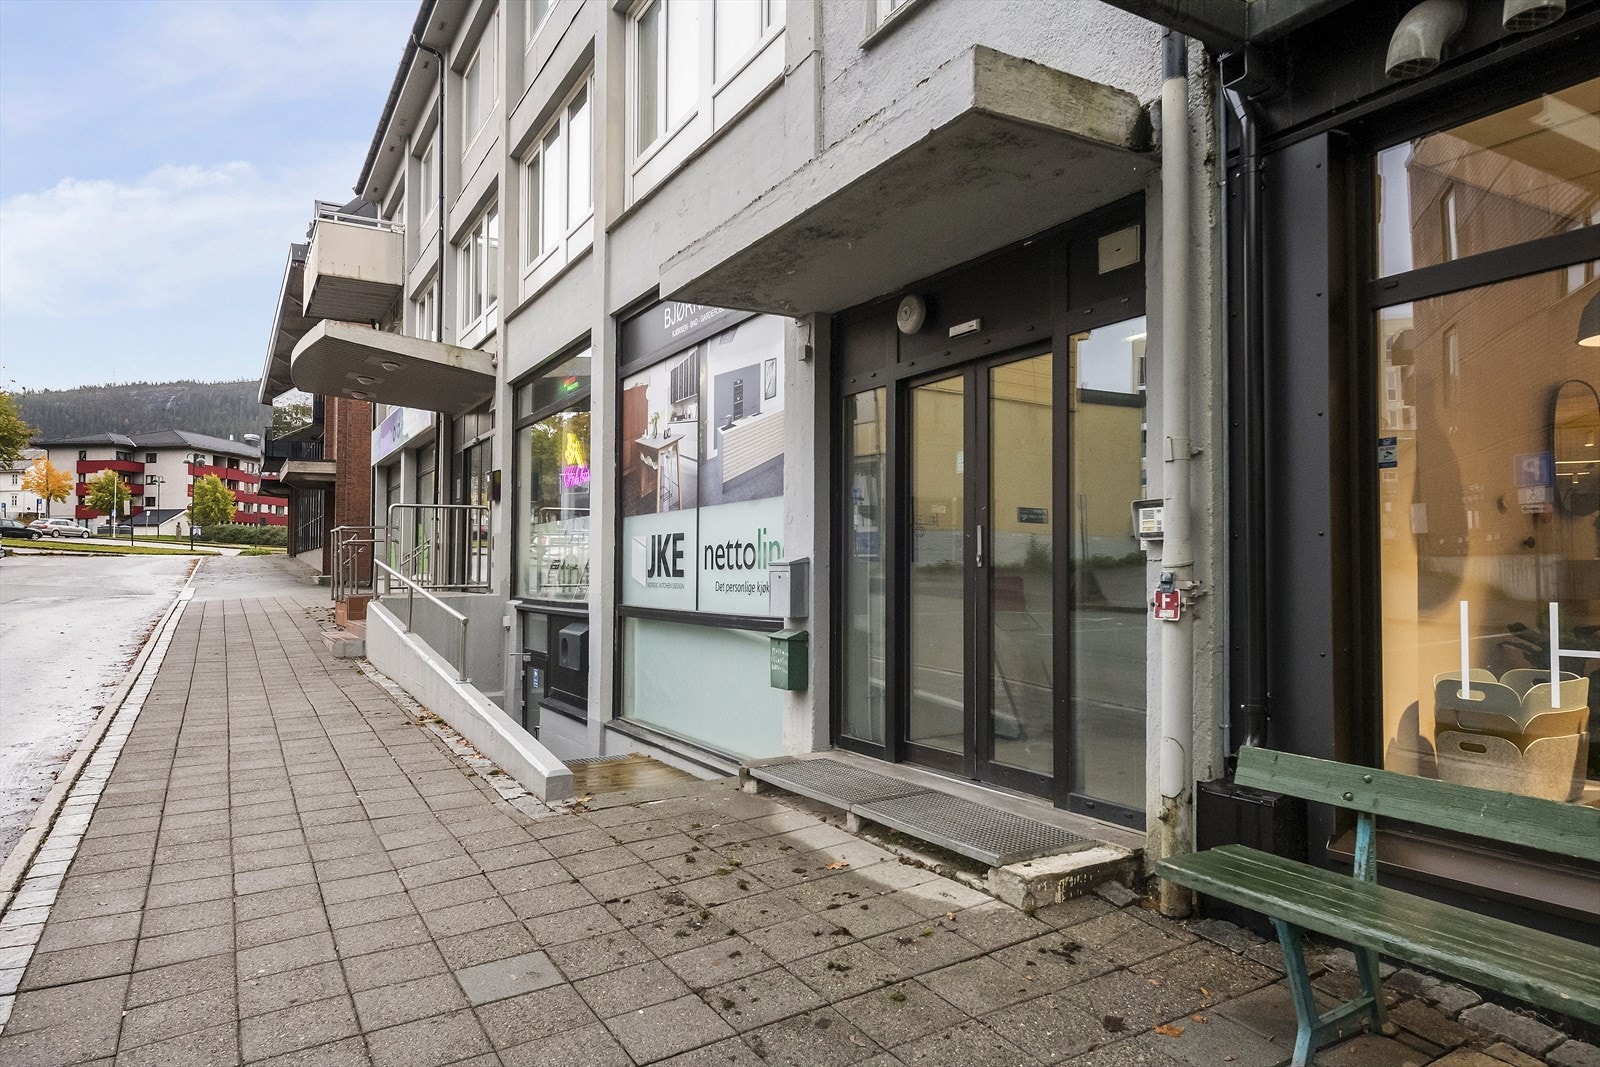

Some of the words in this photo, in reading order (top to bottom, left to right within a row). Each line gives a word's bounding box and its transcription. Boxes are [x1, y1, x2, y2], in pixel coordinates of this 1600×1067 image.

[648, 533, 685, 578] JKE
[704, 528, 784, 570] nettolin
[715, 581, 725, 591] Det
[726, 581, 755, 595] personlige
[1162, 593, 1171, 609] F
